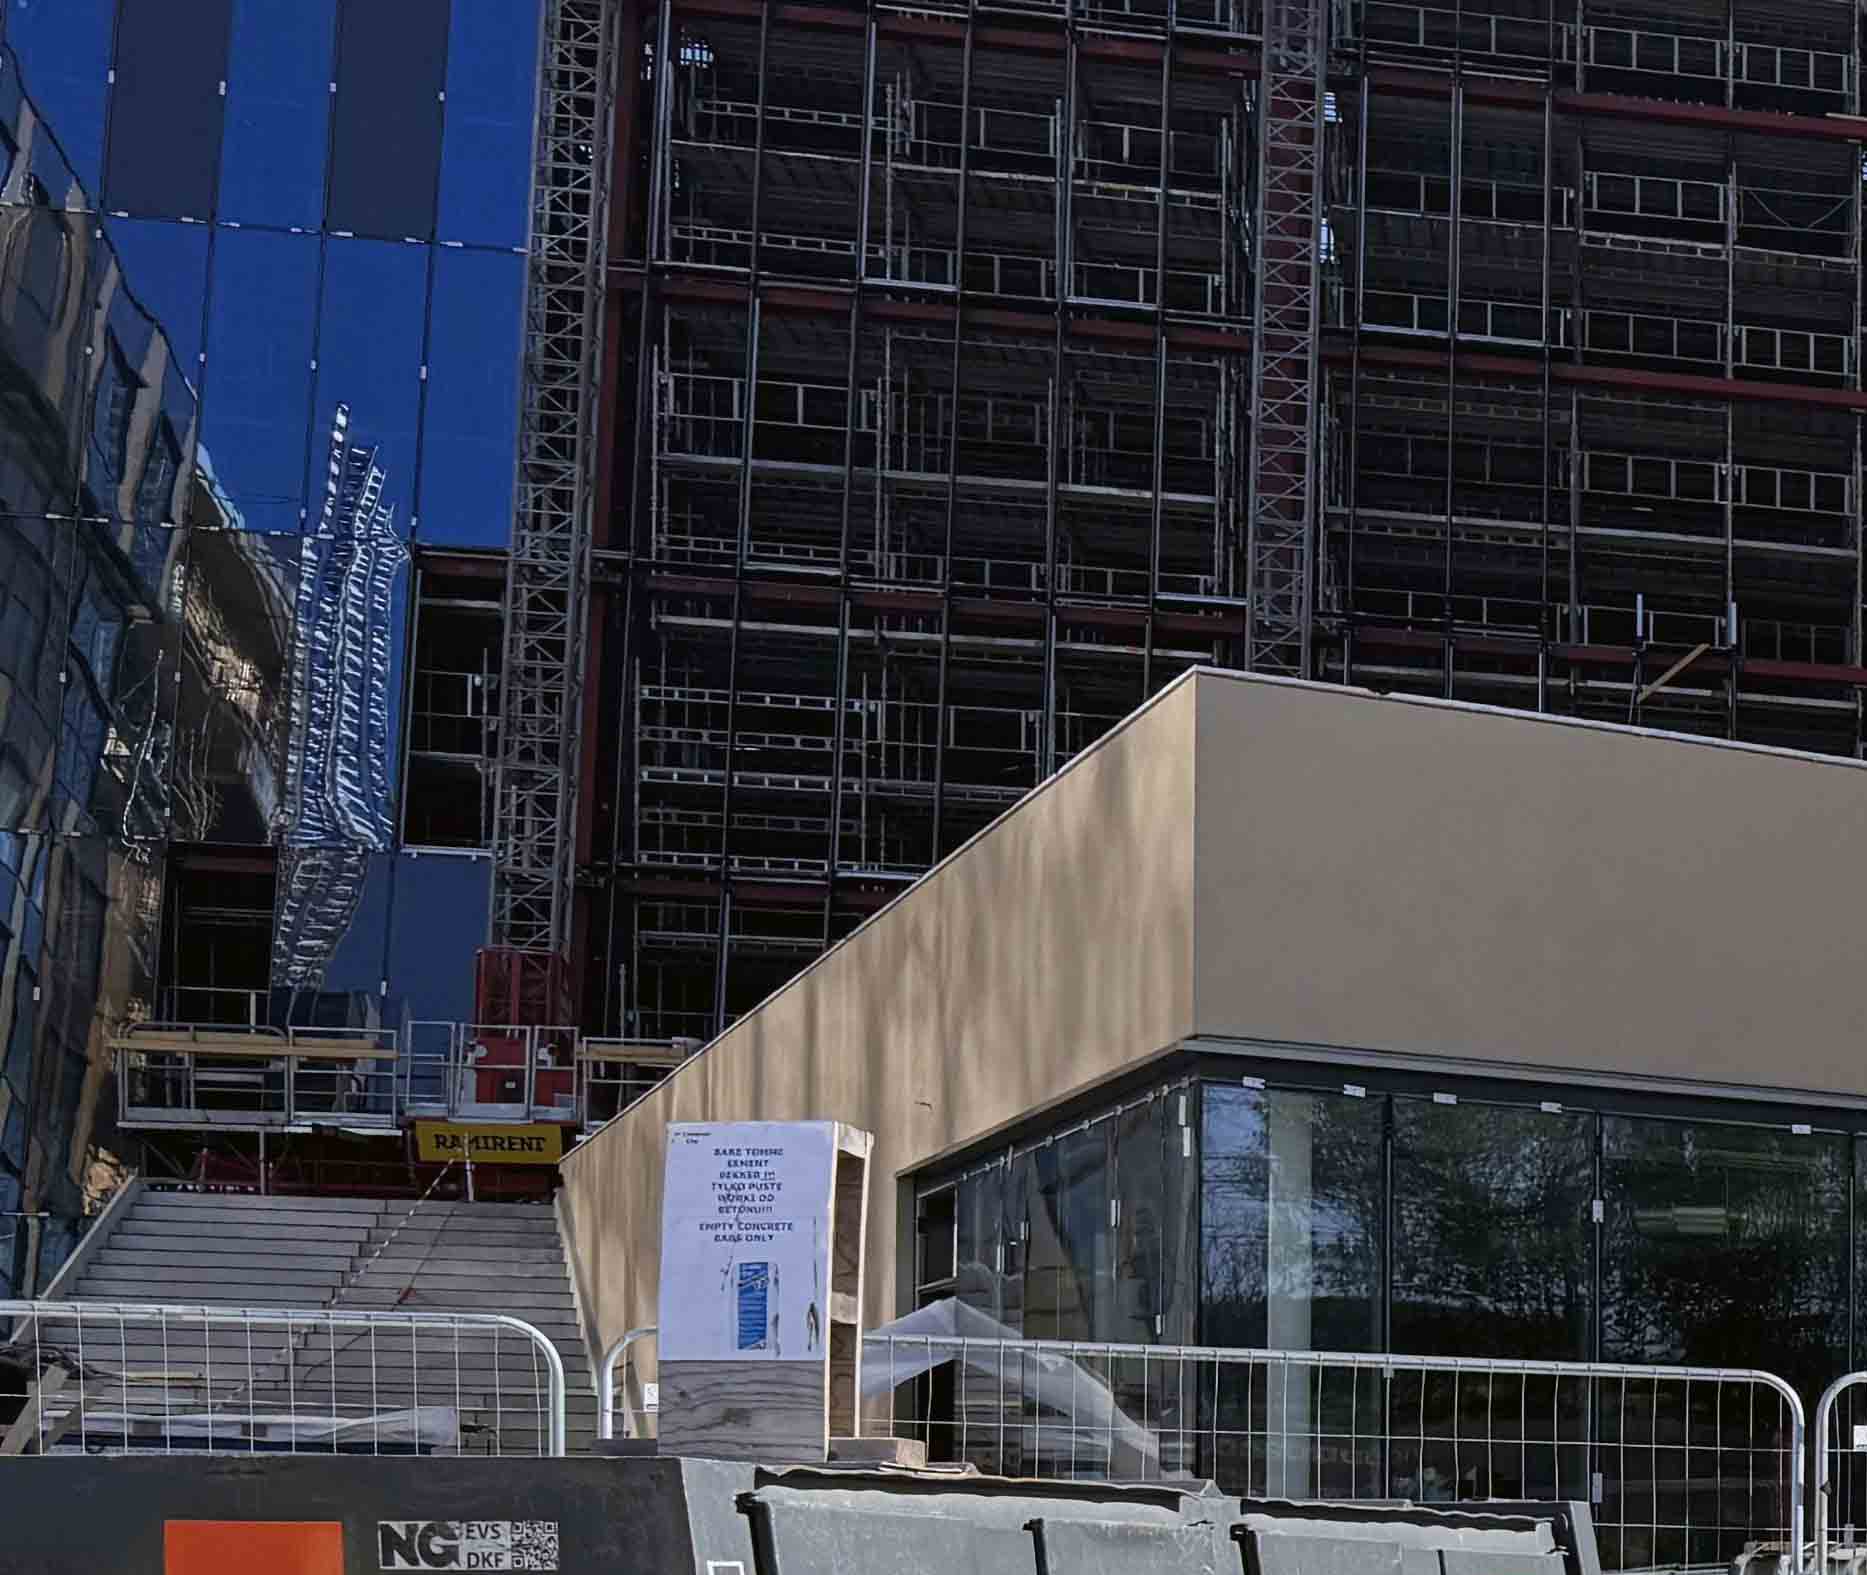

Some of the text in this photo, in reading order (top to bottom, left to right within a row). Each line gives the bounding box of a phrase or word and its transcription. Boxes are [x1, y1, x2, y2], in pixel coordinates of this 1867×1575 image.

[433, 1133, 546, 1151] RAMIRENT
[699, 1222, 793, 1231] EMPTY CONCRETE
[745, 1234, 774, 1242] ONLY
[379, 1522, 501, 1569] NG EVS
[466, 1551, 504, 1569] DKF
